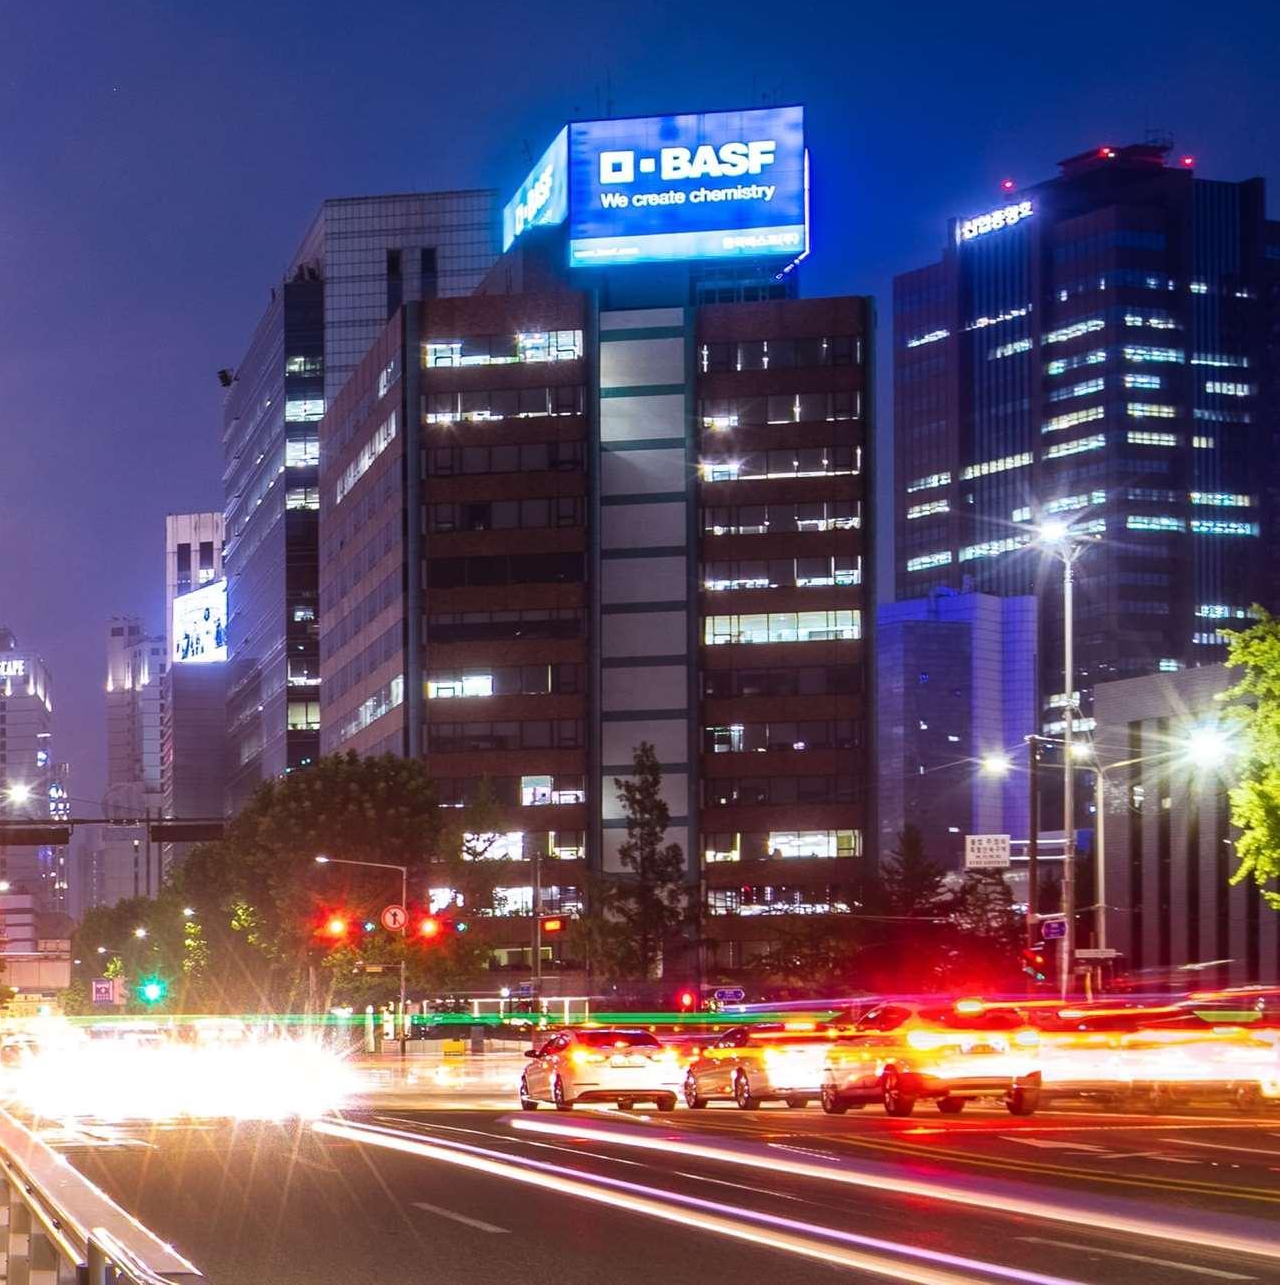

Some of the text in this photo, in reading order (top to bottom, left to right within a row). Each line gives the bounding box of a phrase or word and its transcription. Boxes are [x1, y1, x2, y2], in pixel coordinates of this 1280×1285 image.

[660, 139, 777, 181] BASF
[600, 183, 776, 209] We create chemistry
